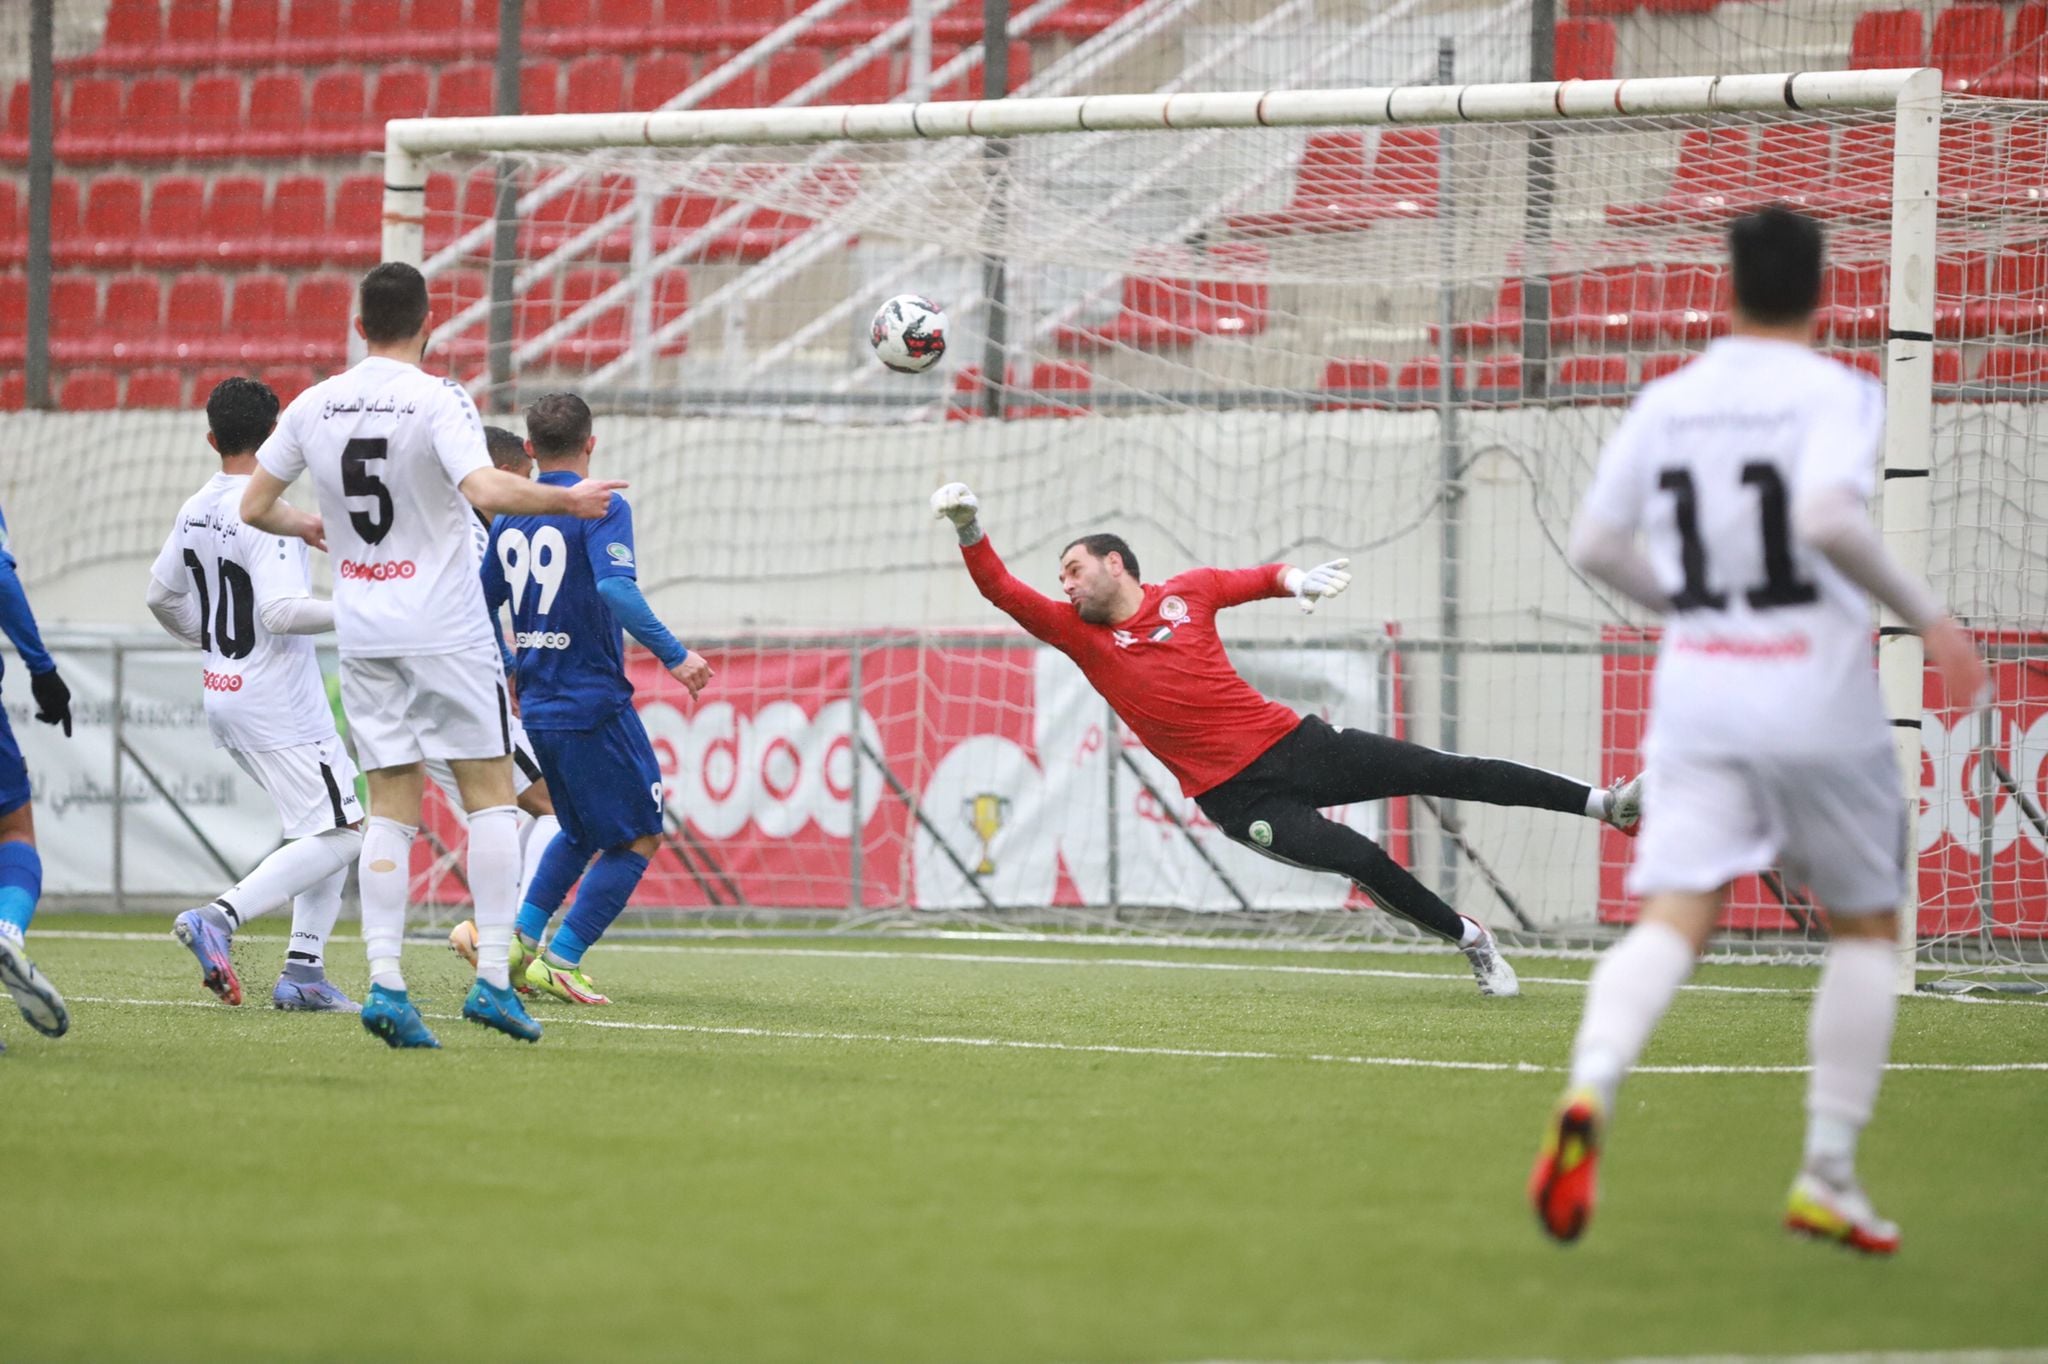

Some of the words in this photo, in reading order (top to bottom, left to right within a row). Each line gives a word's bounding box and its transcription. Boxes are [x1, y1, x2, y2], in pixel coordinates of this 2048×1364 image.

[341, 438, 394, 546] 5
[1659, 463, 1822, 612] 11
[183, 548, 256, 660] 10
[497, 525, 567, 615] 99
